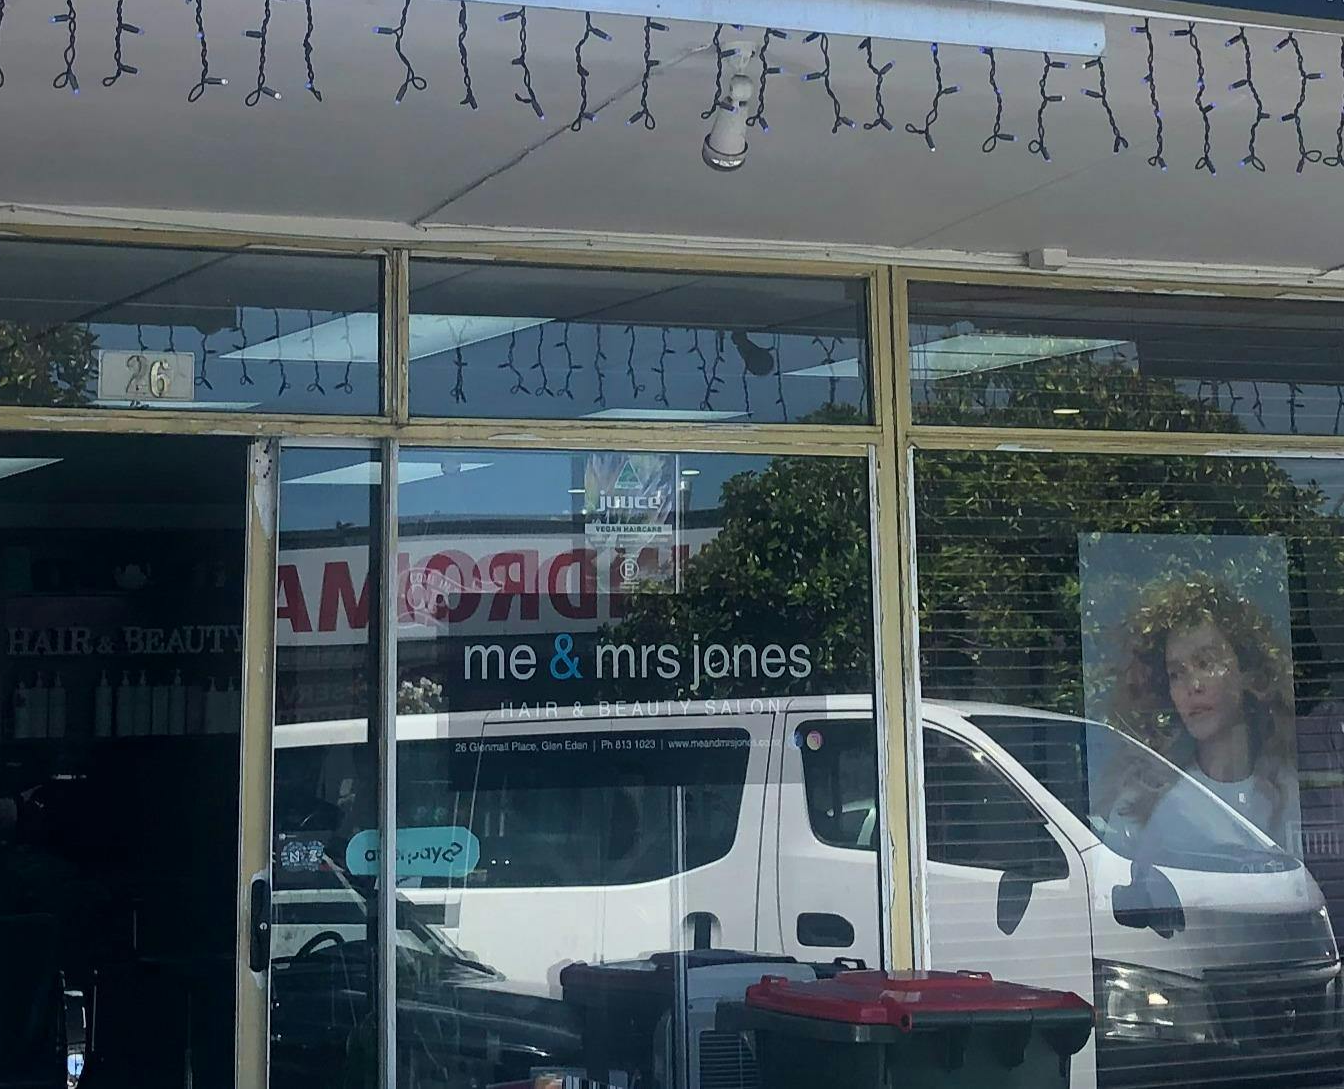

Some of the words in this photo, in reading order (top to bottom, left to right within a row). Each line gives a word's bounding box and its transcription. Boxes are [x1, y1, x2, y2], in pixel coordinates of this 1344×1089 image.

[126, 354, 169, 398] 26
[596, 525, 621, 533] VEGAN
[7, 626, 92, 655] HAIR
[96, 636, 113, 654] &
[124, 624, 243, 654] BEAUTY
[464, 643, 536, 680] me
[550, 633, 583, 679] &
[596, 643, 680, 679] mrs
[689, 635, 812, 689] jones
[500, 701, 558, 718] HAIR
[572, 700, 584, 717] &
[599, 699, 691, 716] BEAUTY
[705, 698, 780, 715] SALON
[512, 741, 537, 752] Place,
[541, 740, 562, 751] Glen
[565, 740, 587, 750] Eden
[601, 739, 613, 749] Ph
[615, 739, 632, 749] 813
[635, 739, 655, 749] 1023
